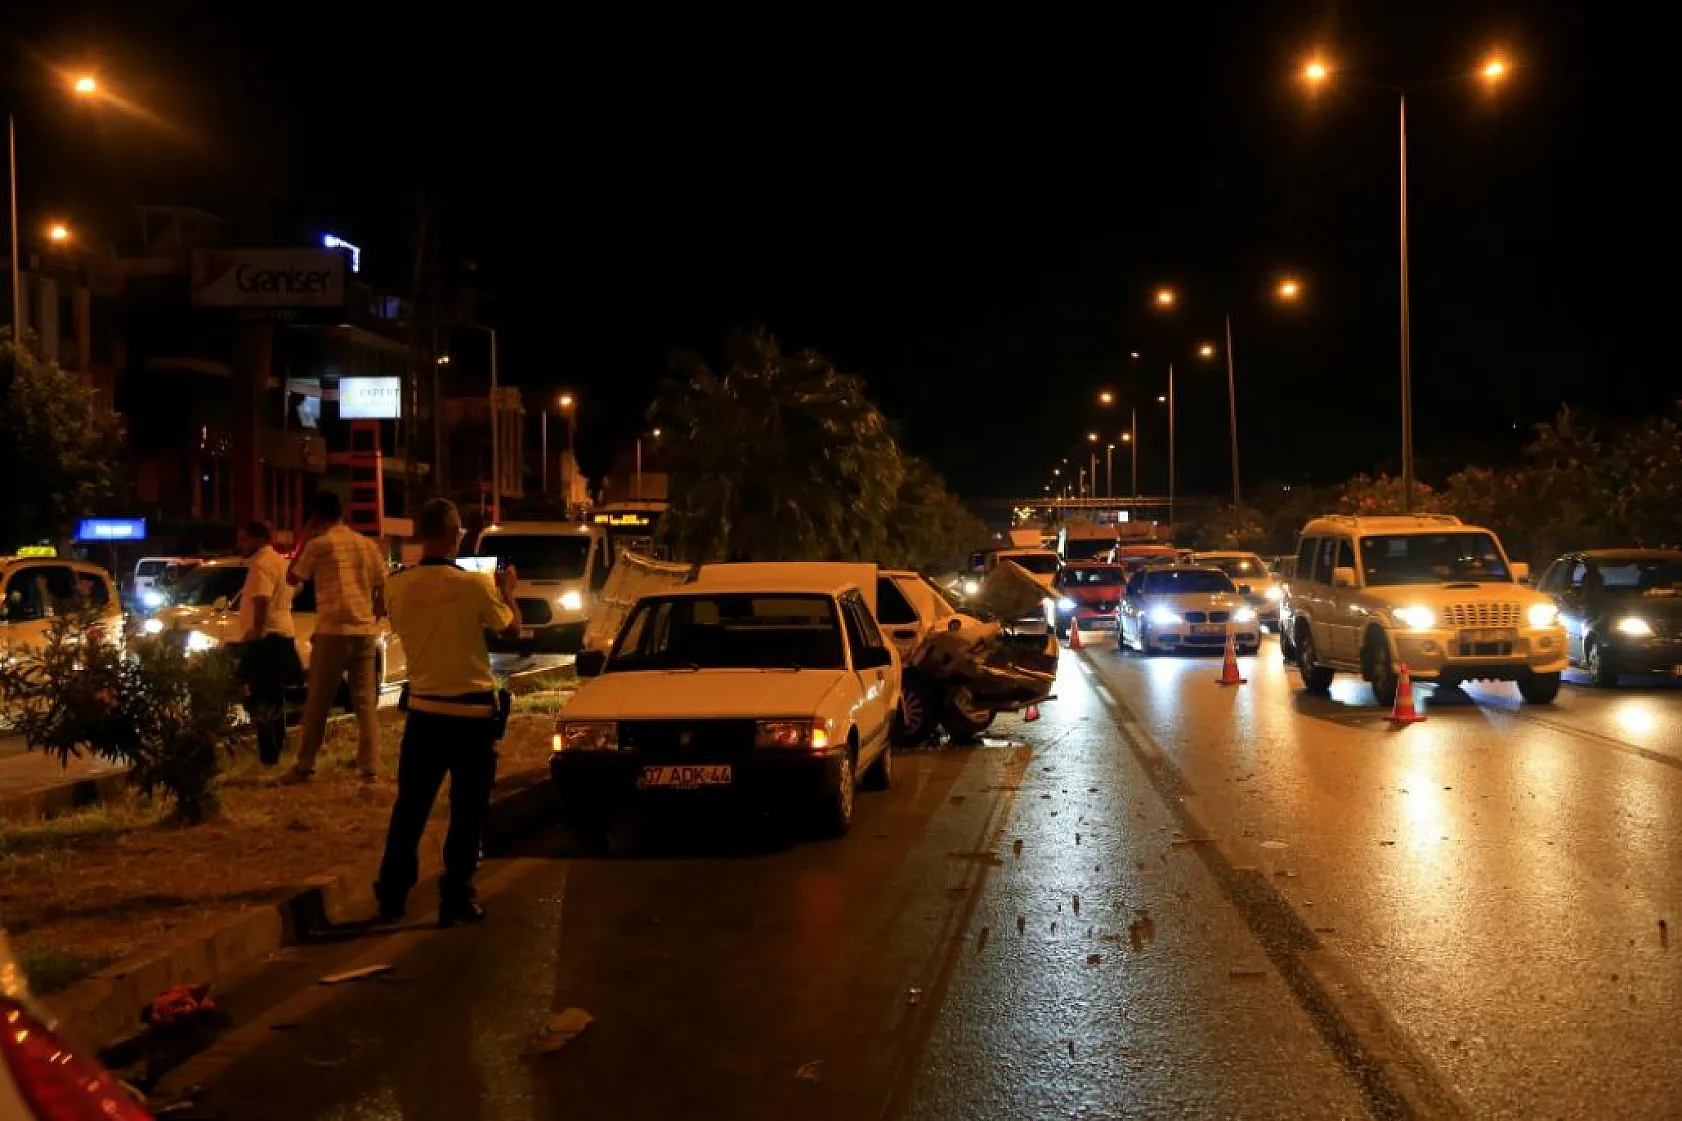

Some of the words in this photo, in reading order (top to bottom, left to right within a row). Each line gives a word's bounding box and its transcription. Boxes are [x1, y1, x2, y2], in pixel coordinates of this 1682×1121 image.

[237, 263, 331, 293] Graniser
[644, 767, 662, 784] 07
[672, 767, 704, 783] ADK
[711, 767, 730, 782] 44
